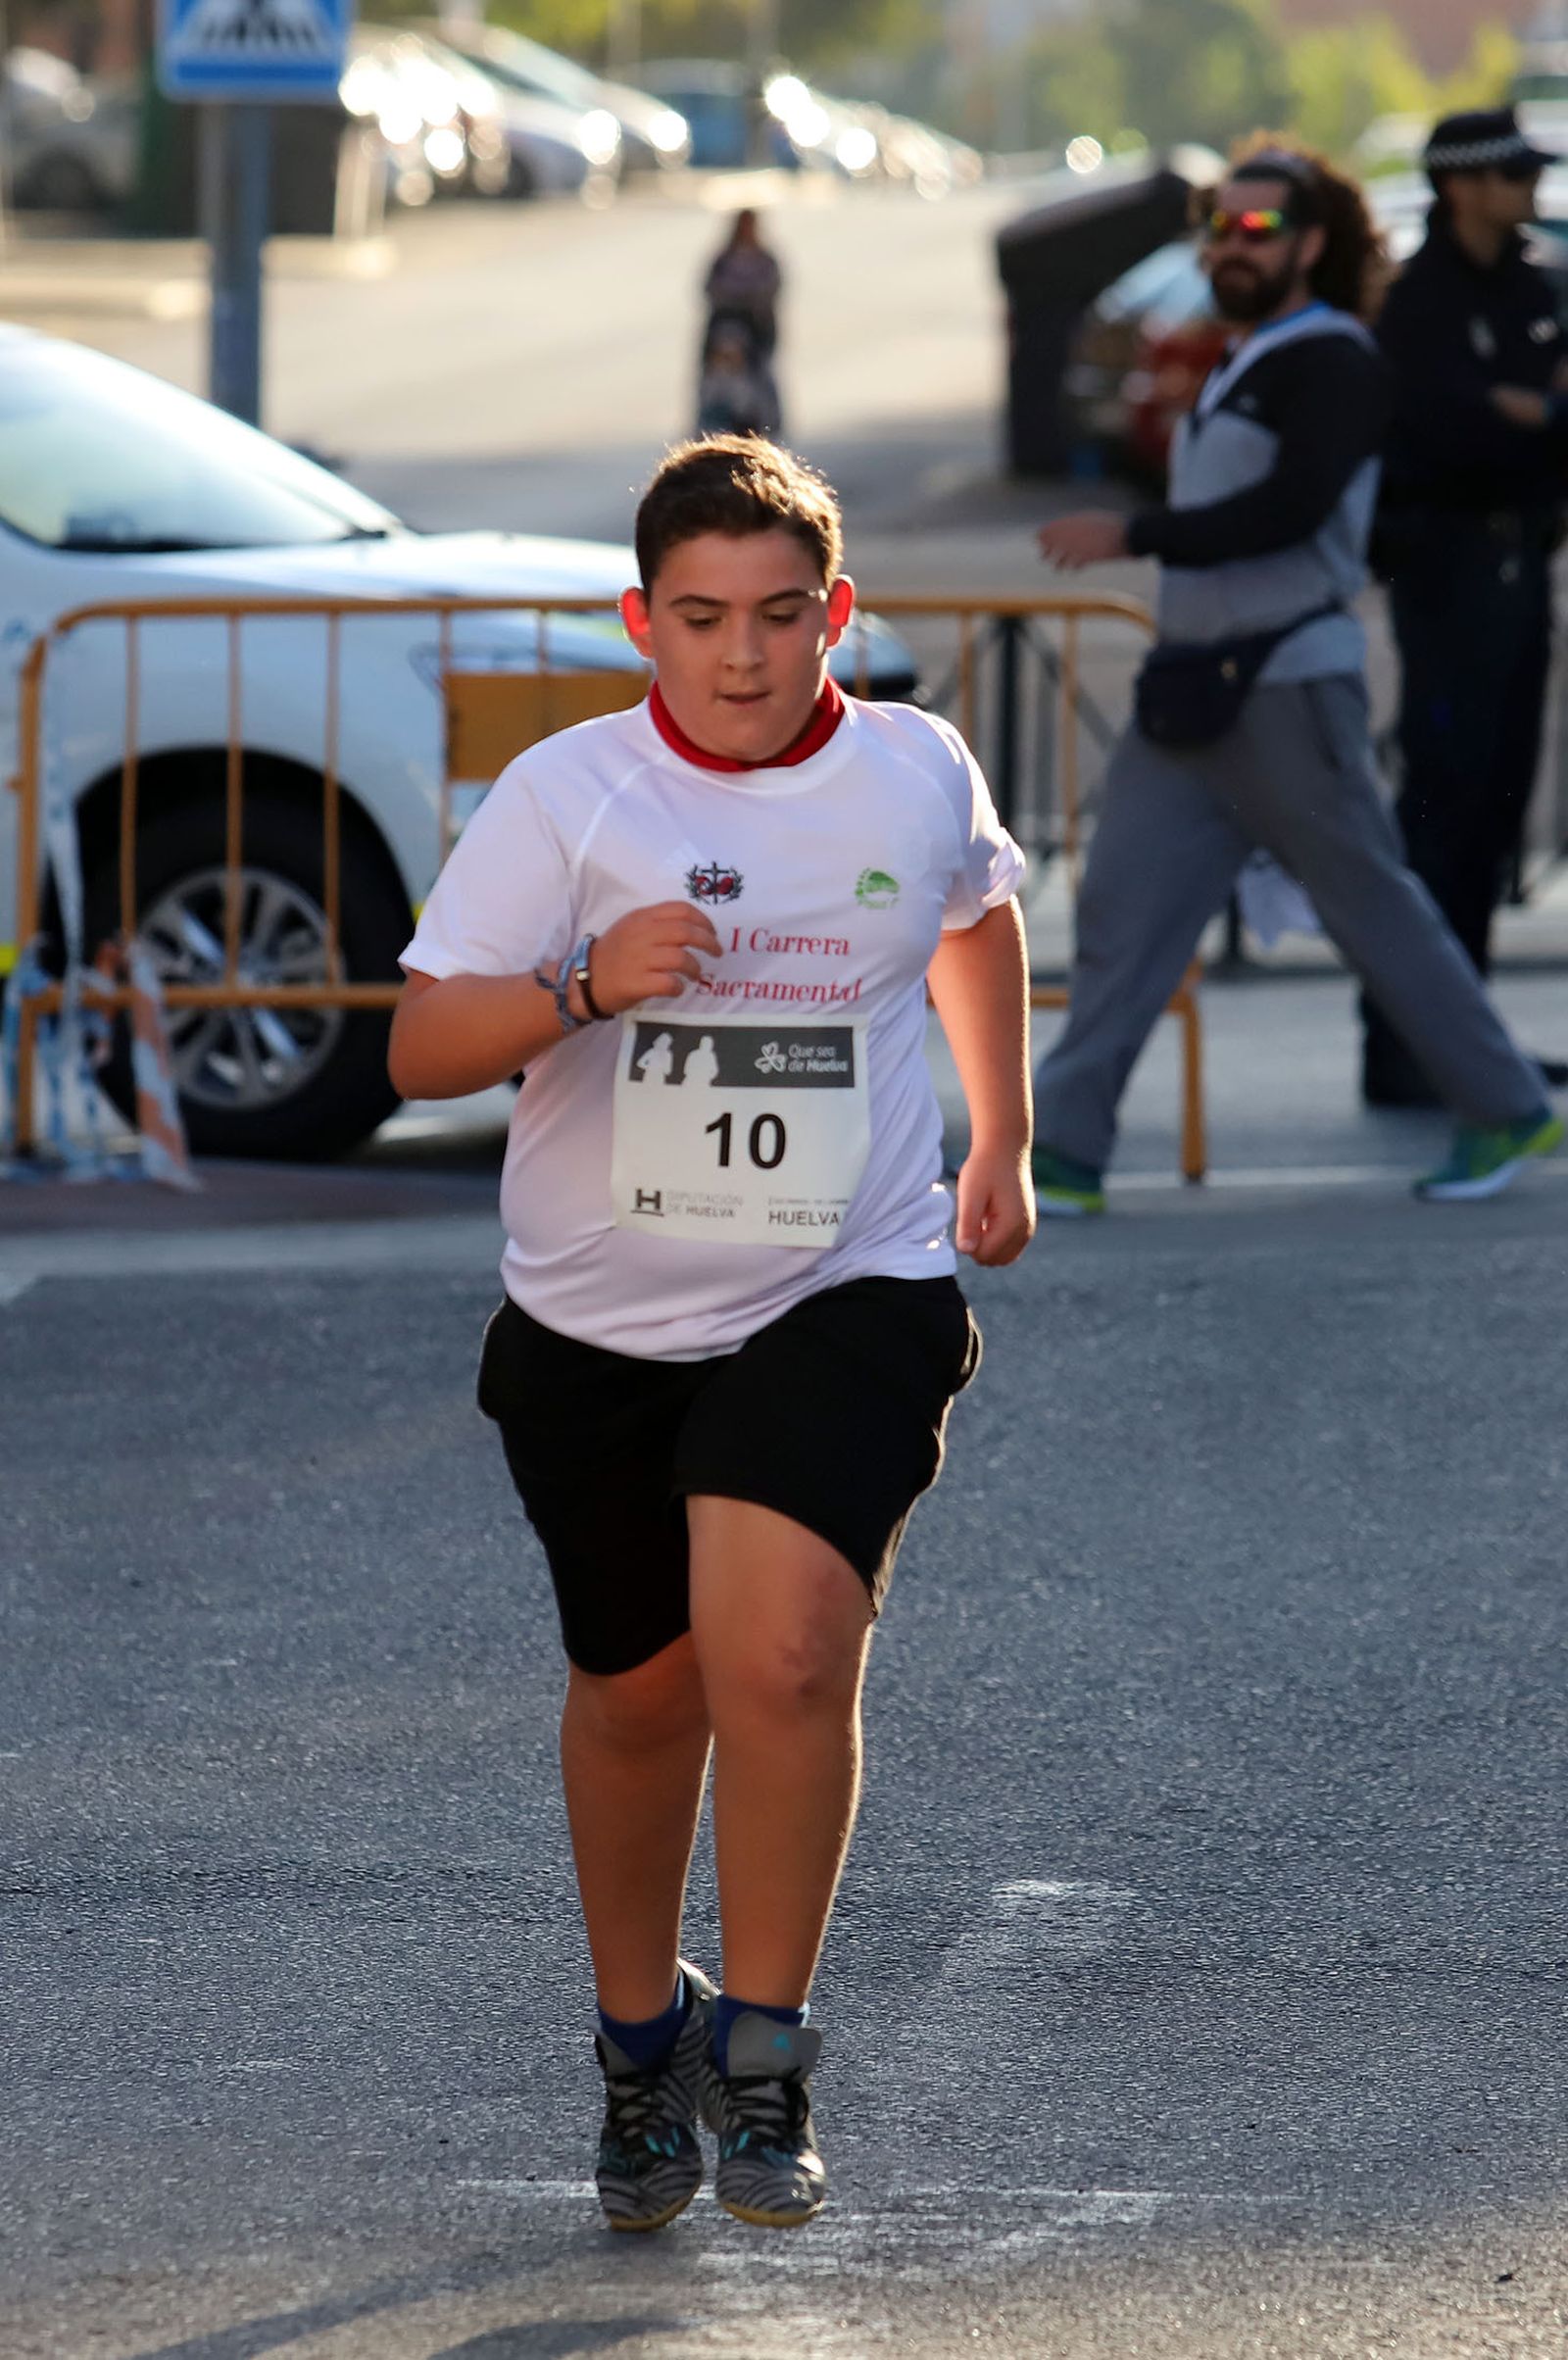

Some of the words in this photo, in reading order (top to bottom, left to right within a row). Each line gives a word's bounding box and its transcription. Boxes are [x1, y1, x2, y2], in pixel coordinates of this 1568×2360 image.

[730, 926, 740, 953] I
[749, 927, 850, 956] Carrera
[695, 973, 862, 1004] Sacramental
[788, 1044, 814, 1058] Que
[815, 1046, 836, 1057] sea
[788, 1060, 805, 1072] de
[807, 1059, 849, 1072] Huelva
[706, 1112, 786, 1169] 10
[667, 1203, 682, 1215] DE
[686, 1205, 736, 1218] HUELVA
[768, 1210, 840, 1226] HUELVA
